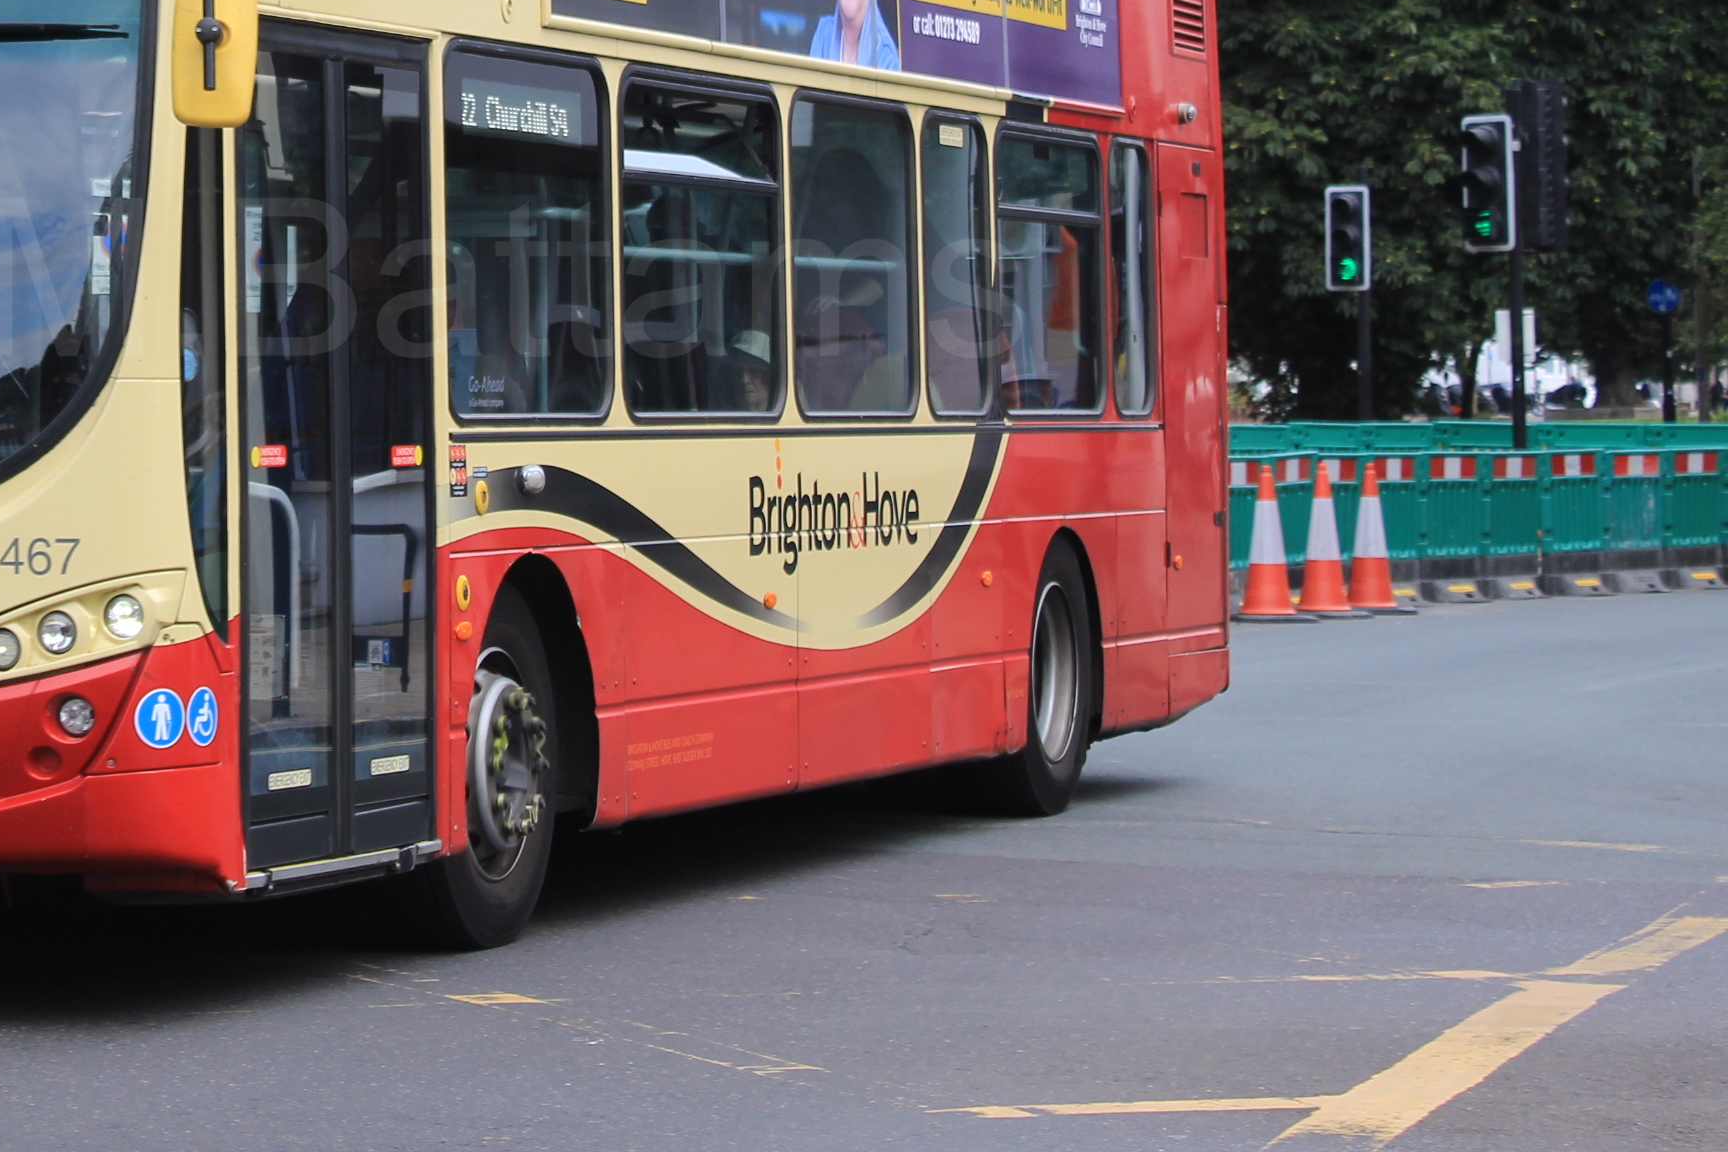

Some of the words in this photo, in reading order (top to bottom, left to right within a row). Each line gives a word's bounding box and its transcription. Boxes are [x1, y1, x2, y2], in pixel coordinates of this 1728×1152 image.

[913, 16, 920, 34] or
[921, 13, 934, 37] call:
[934, 14, 955, 40] 01273
[468, 375, 504, 393] Go-Ahead
